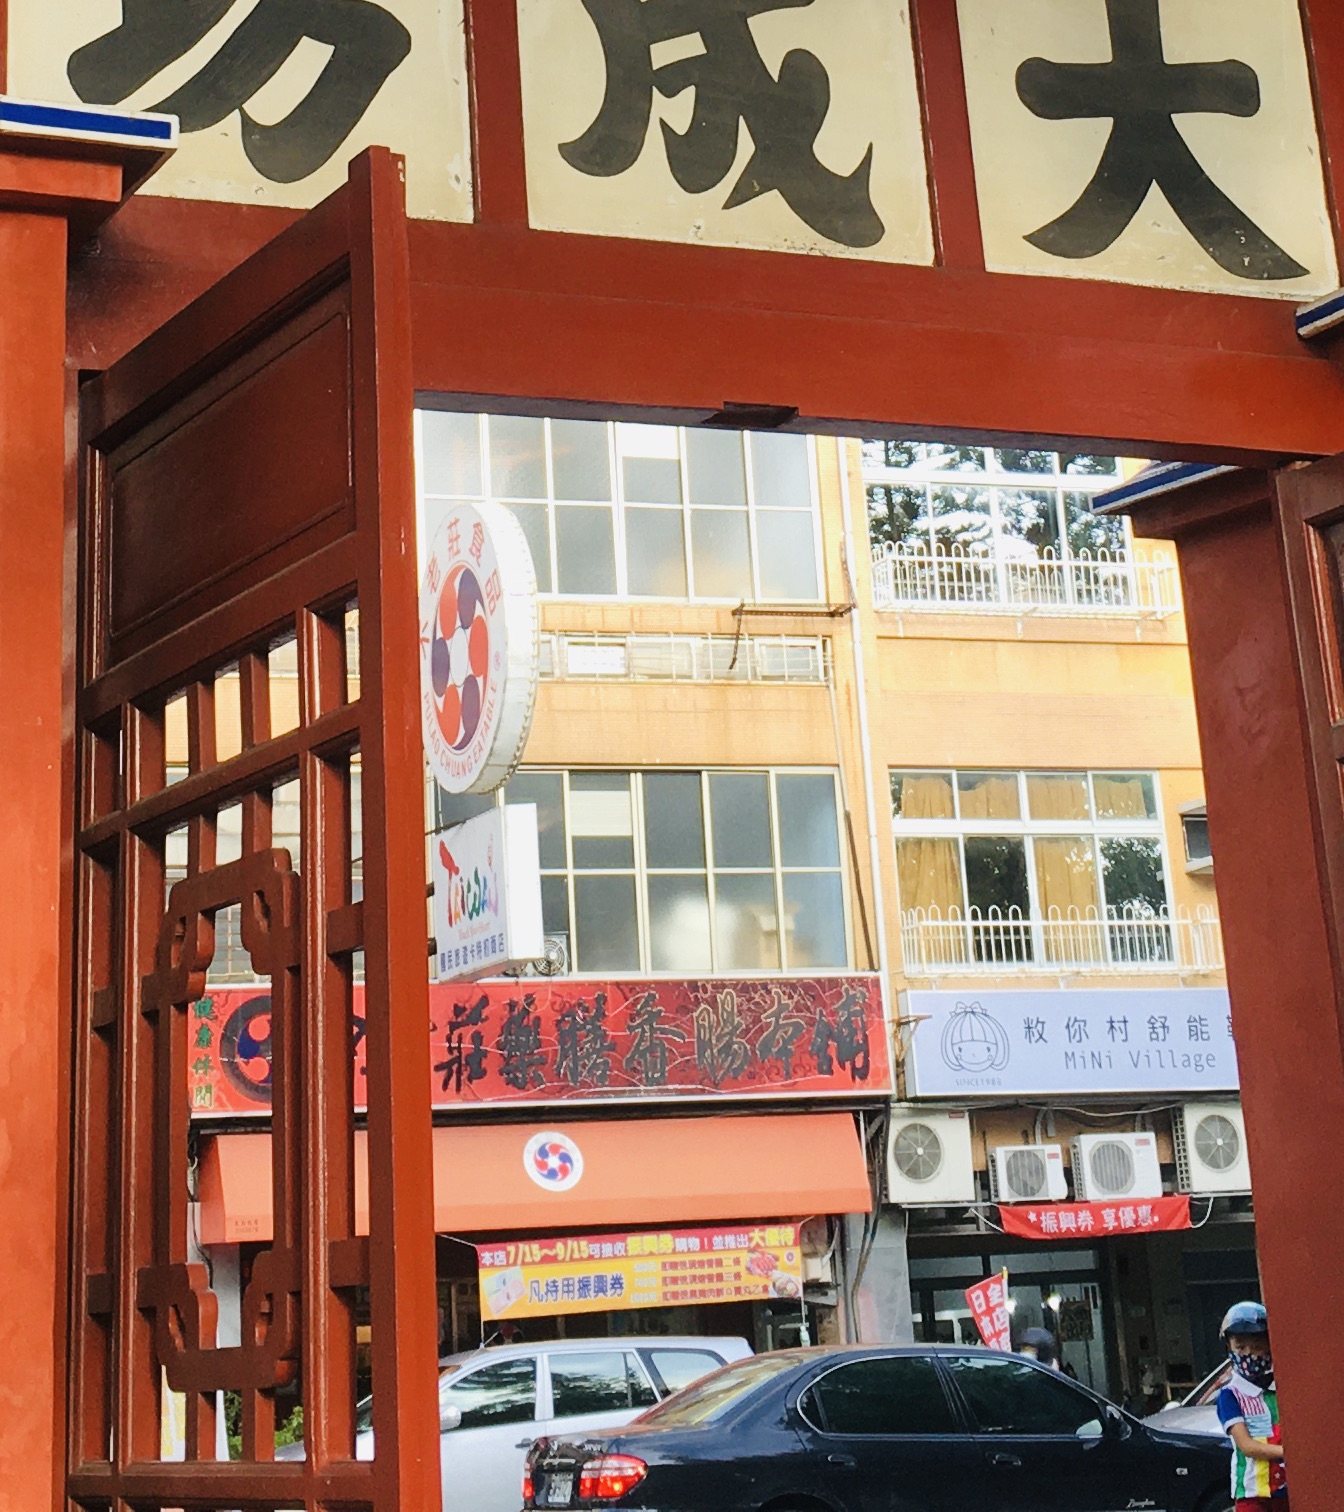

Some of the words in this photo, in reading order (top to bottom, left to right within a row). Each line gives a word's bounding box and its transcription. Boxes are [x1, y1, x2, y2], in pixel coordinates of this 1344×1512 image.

[440, 750, 473, 779] CHUANG
[473, 681, 498, 764] EATABLE
[192, 995, 218, 1108] 健康休閒
[353, 986, 870, 1094] 莊藥膳香腸本舖
[1064, 1050, 1113, 1070] MiNi
[1128, 1049, 1217, 1073] Village
[1040, 1210, 1094, 1233] 振興券
[1101, 1205, 1153, 1230] 享優惠
[528, 1273, 624, 1303] 凡持用振興券
